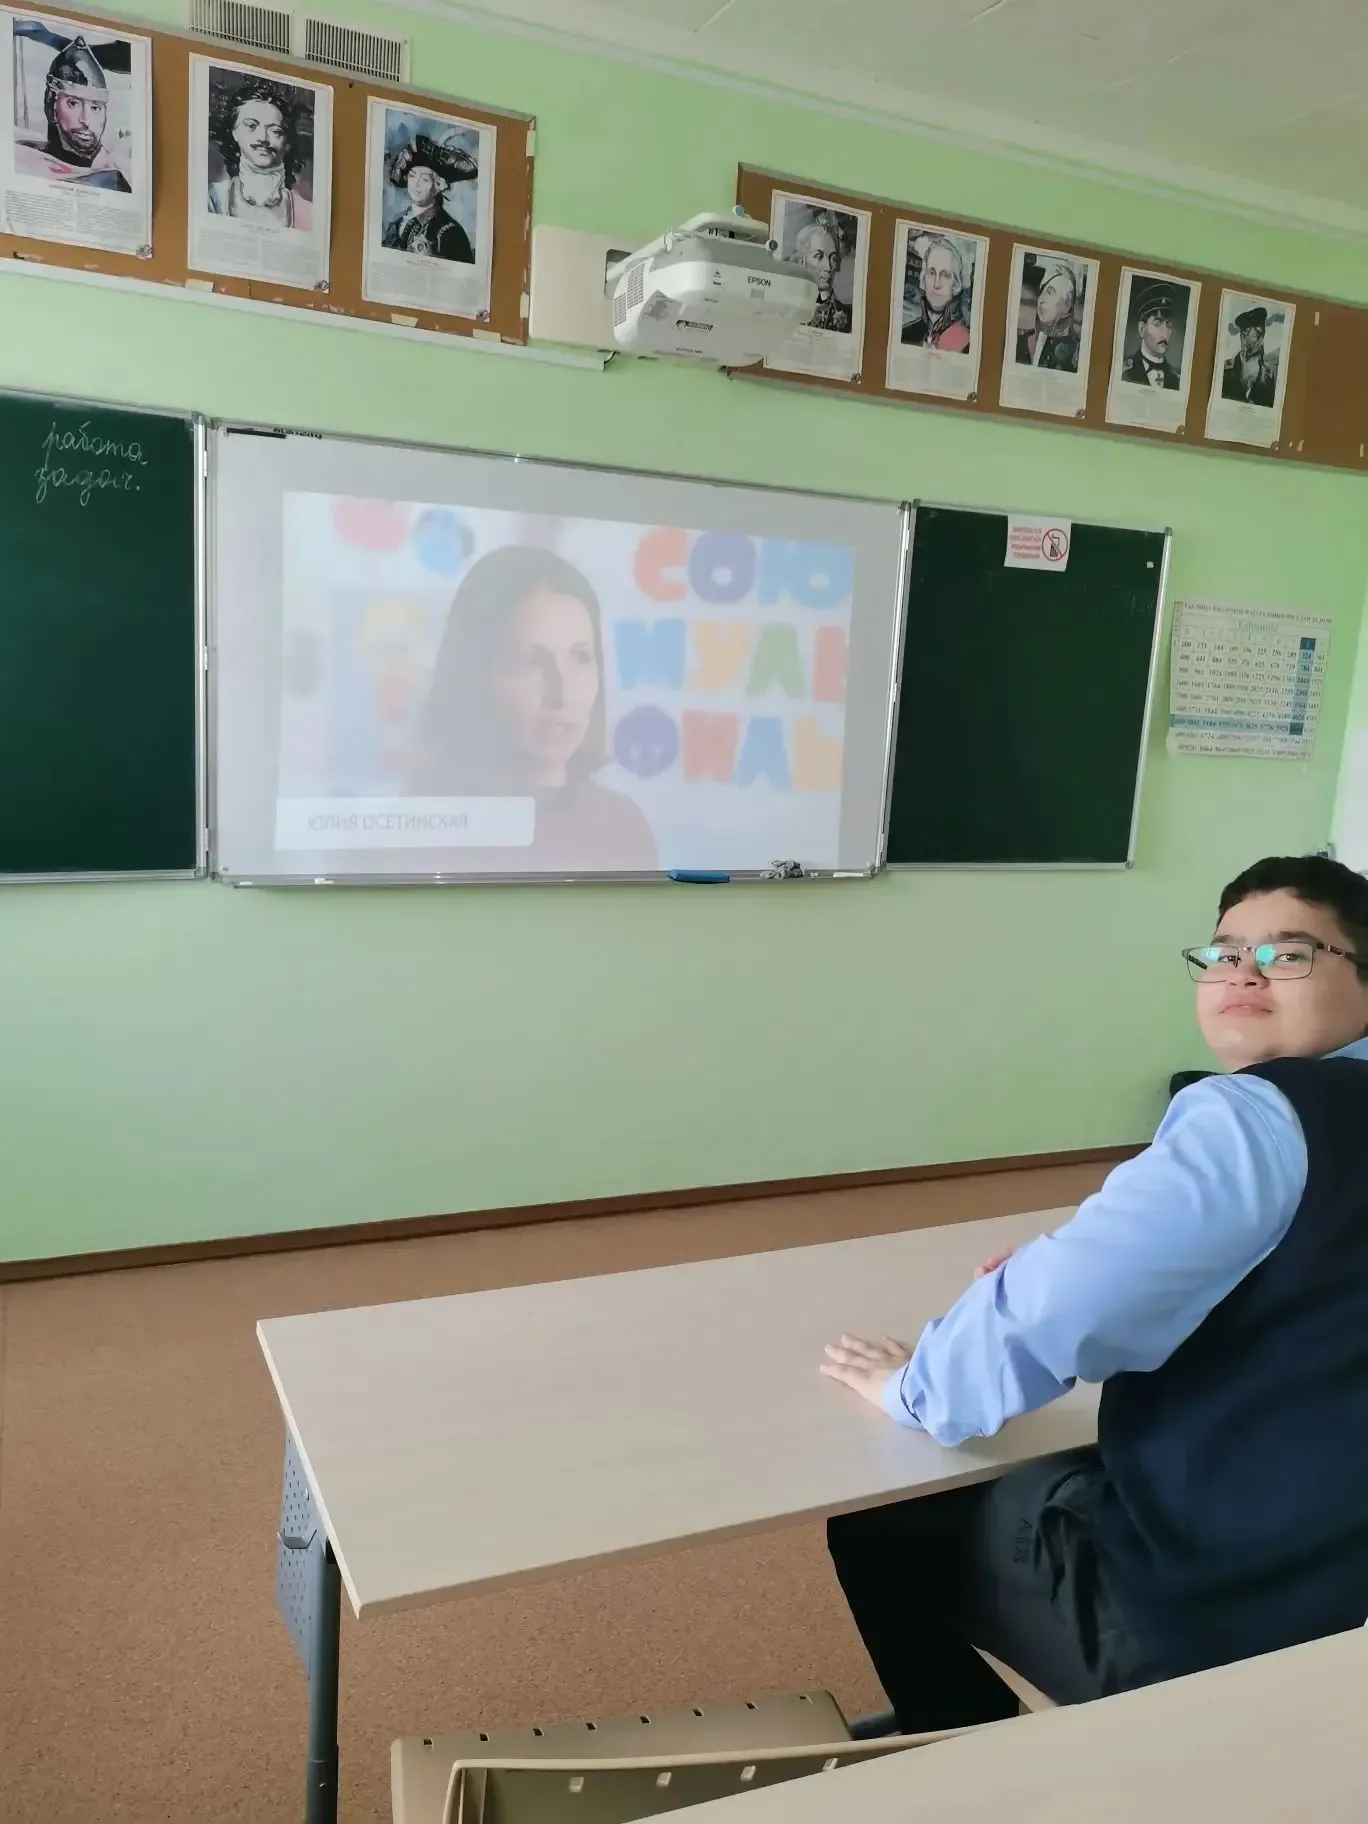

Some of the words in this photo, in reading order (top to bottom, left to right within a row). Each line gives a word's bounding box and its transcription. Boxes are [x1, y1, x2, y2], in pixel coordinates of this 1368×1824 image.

[747, 276, 771, 287] EPSON
[307, 814, 358, 831] ЮЛИЯ
[362, 813, 468, 830] ОСЕТИНСКАЯ
